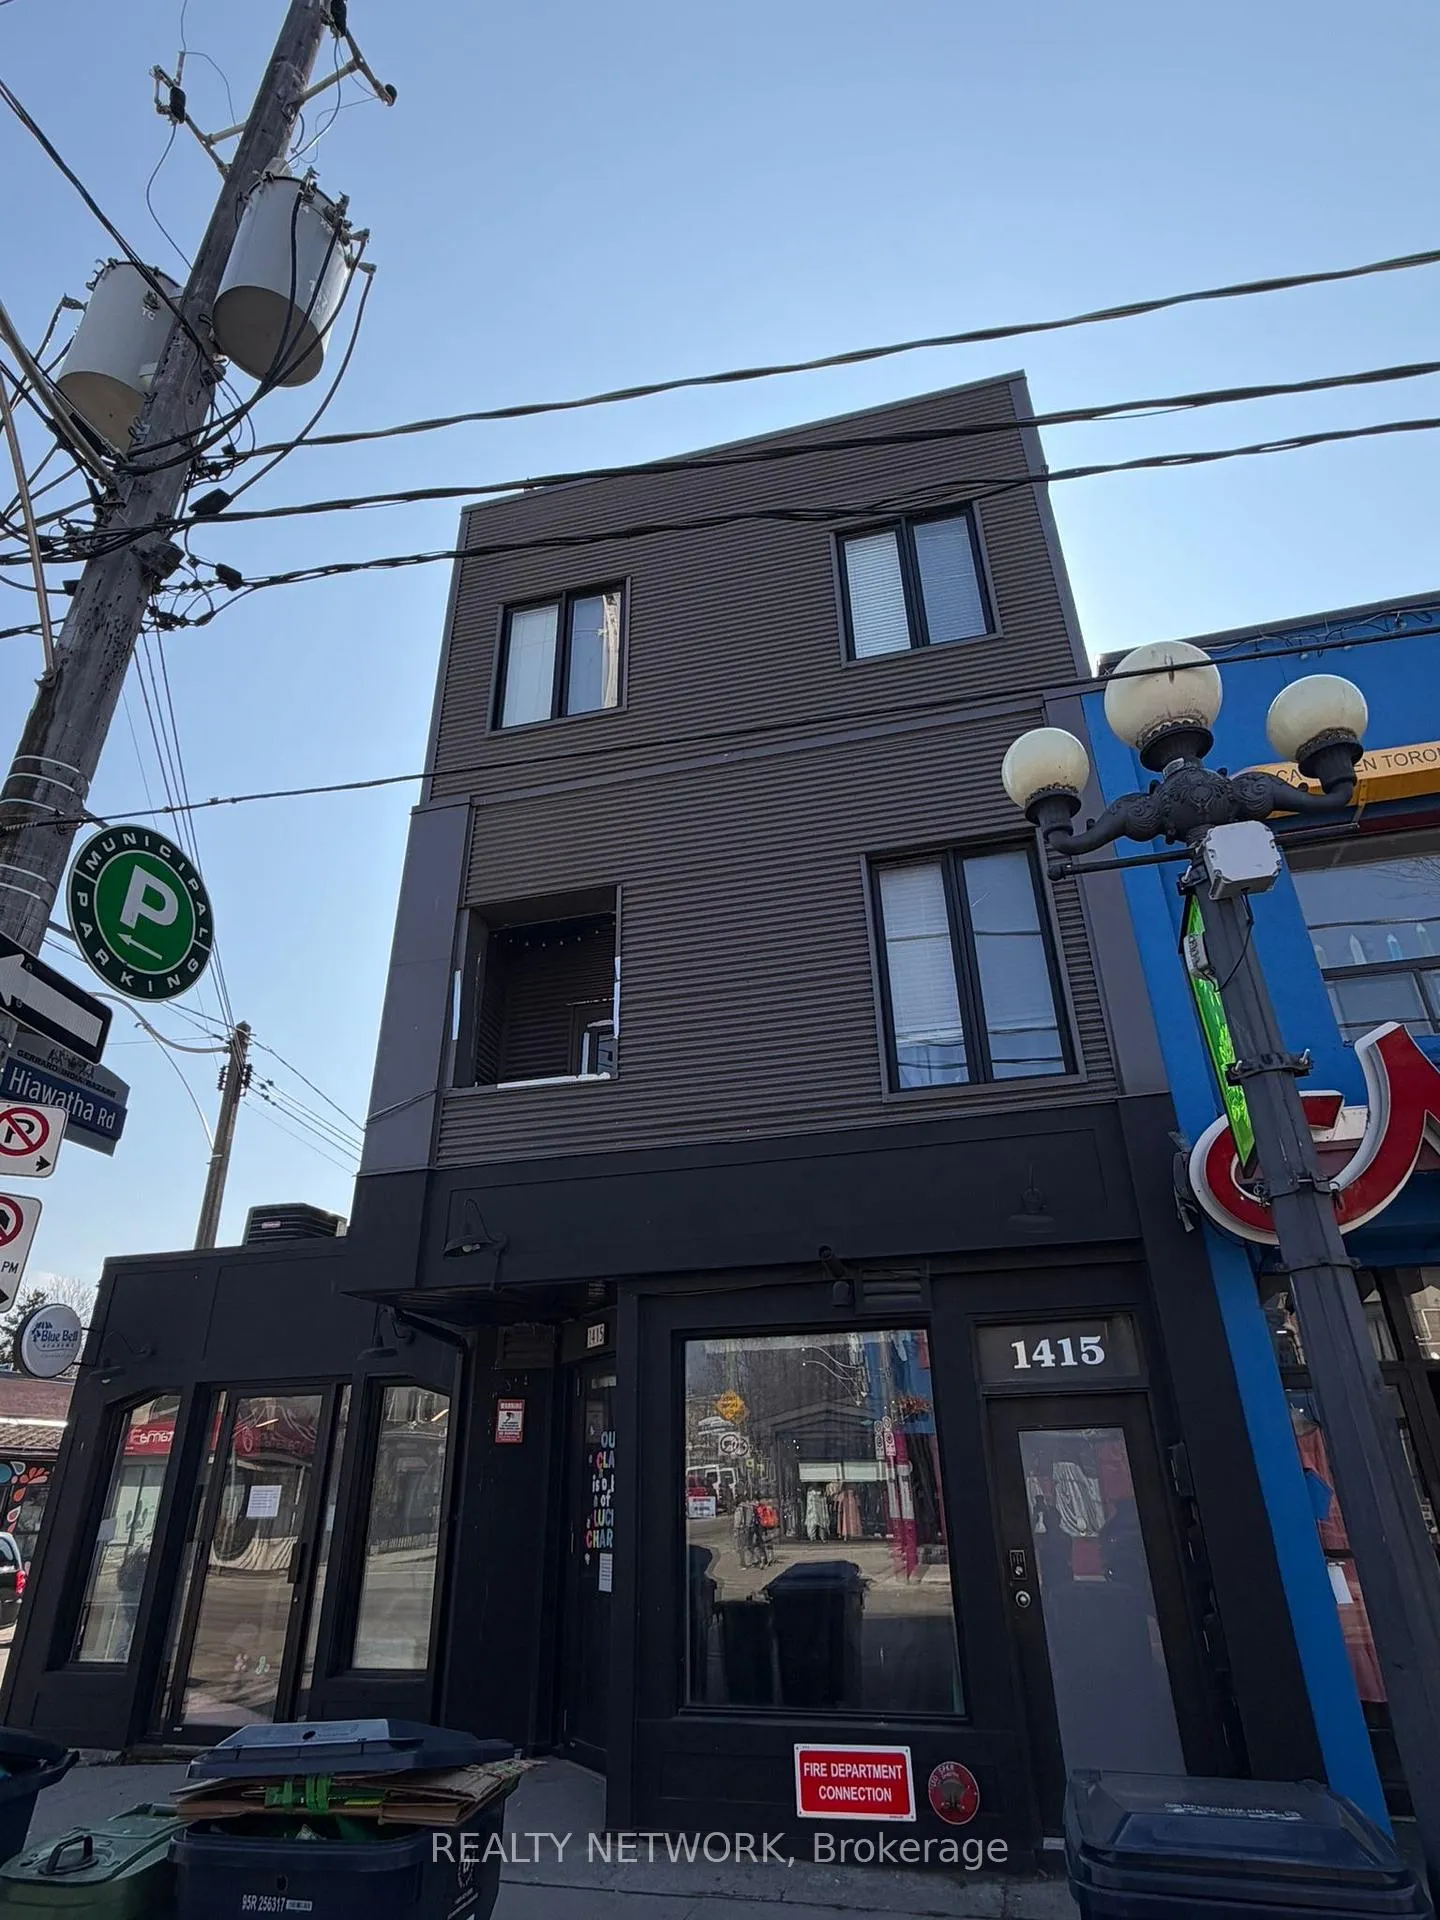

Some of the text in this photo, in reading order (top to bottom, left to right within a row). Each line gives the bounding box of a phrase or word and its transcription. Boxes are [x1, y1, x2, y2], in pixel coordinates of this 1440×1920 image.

[1380, 746, 1440, 769] TORO
[85, 832, 209, 938] MUNICIPAL
[77, 891, 199, 993] PARKING
[9, 1066, 117, 1131] Hiawatha Rd
[1, 1261, 19, 1274] PM
[41, 1330, 79, 1342] Blue Bell
[1011, 1335, 1105, 1369] 1415
[803, 1761, 903, 1780] FIRE DEPARTMENT
[818, 1785, 892, 1802] CONNECTION
